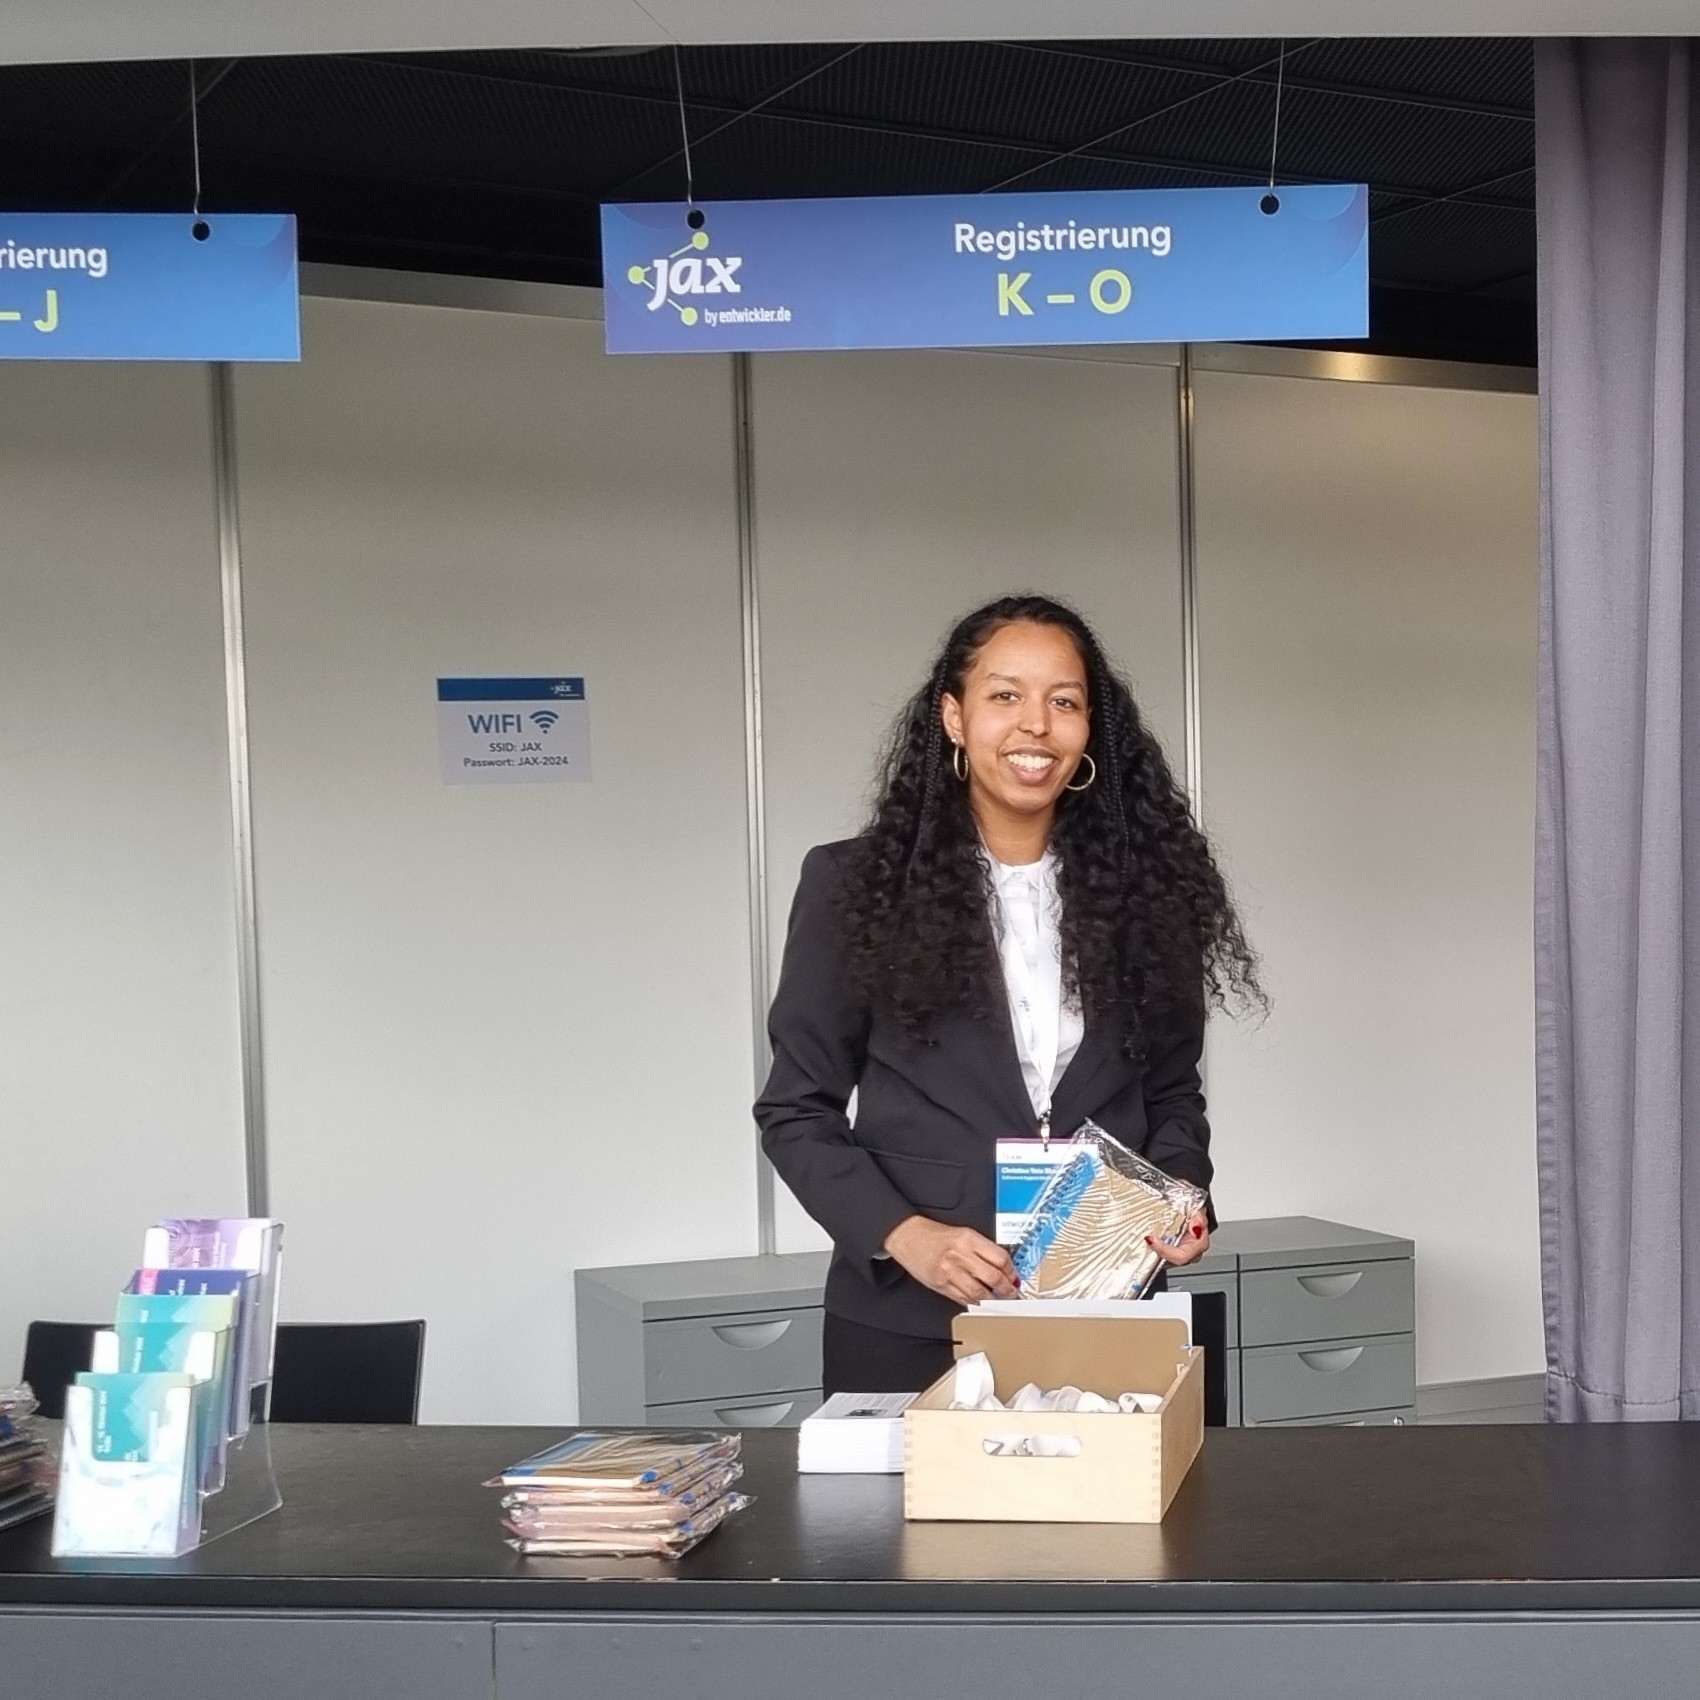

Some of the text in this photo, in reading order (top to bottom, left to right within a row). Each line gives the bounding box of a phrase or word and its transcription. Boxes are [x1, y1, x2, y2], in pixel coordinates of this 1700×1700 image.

[954, 219, 1172, 260] Registrierung
[646, 256, 742, 311] jax
[998, 271, 1034, 316] K
[1089, 268, 1132, 315] O
[34, 289, 58, 332] J
[704, 306, 791, 327] by entwickler.de
[467, 714, 522, 734] WIFI
[463, 756, 569, 767] Passwort: JAX-2024
[489, 742, 542, 752] SSID: JAX
